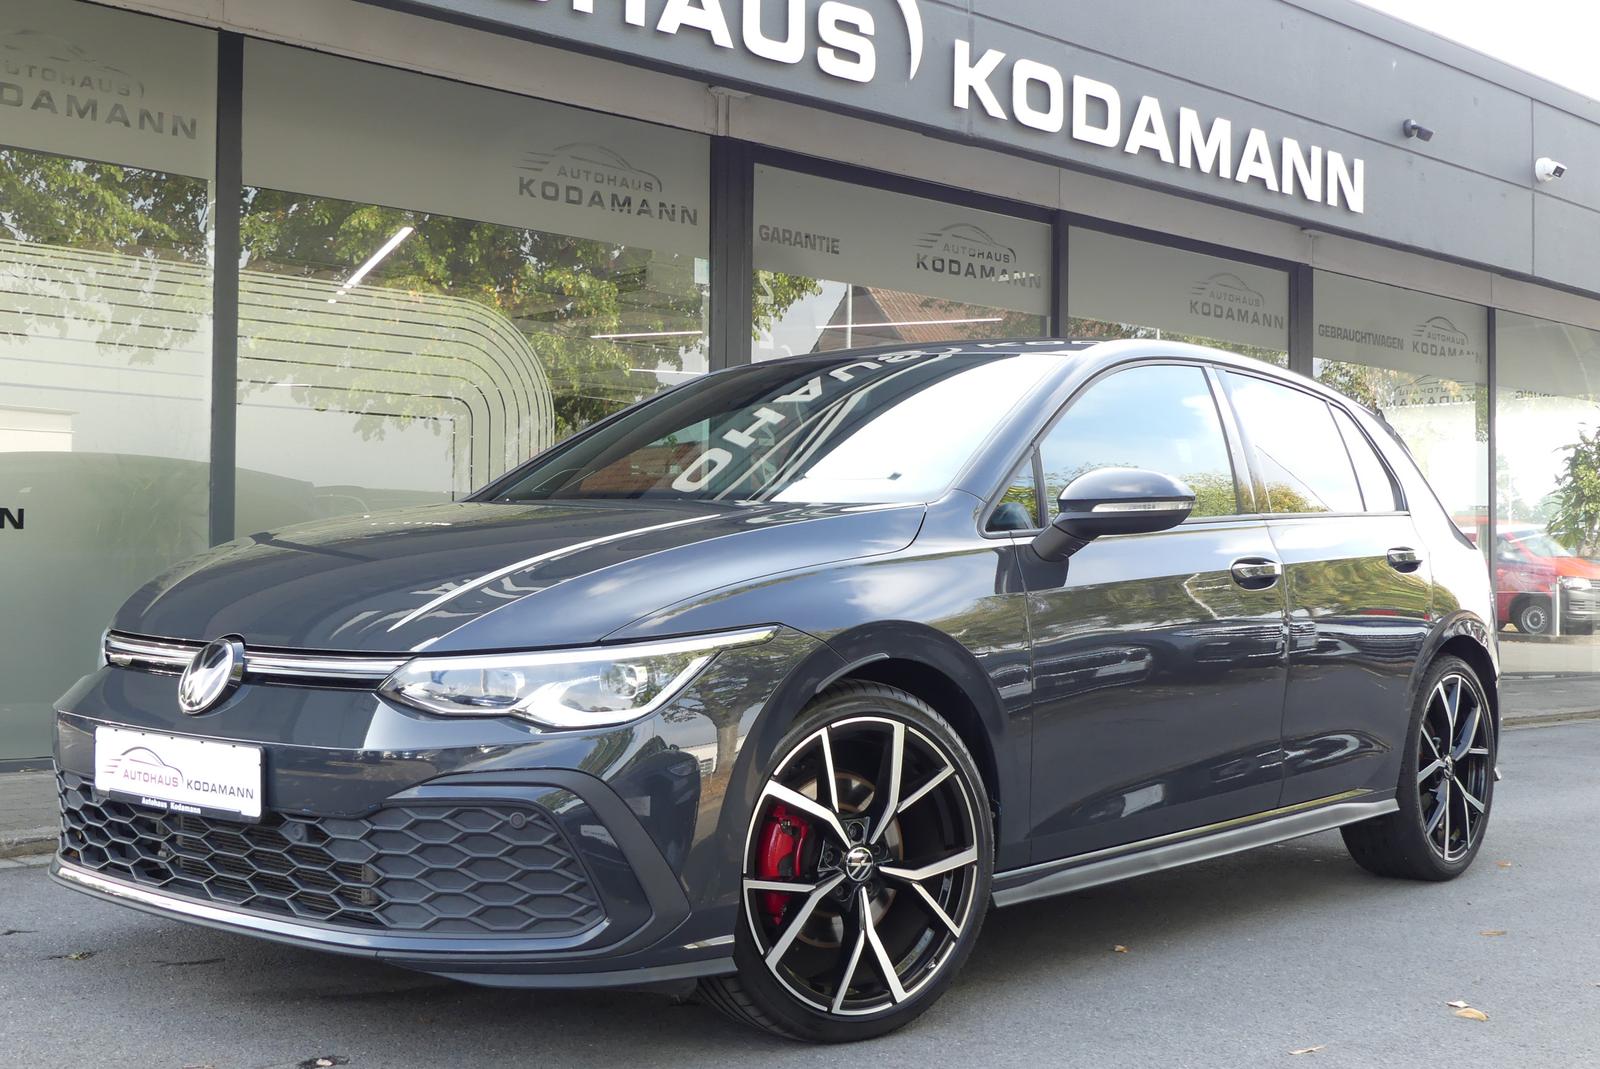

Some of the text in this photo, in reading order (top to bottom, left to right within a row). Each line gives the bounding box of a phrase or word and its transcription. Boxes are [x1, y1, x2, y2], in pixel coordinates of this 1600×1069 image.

[522, 0, 877, 83] AUS
[953, 39, 1364, 214] KODAMANN
[557, 165, 653, 192] AUTOHAUS
[518, 176, 698, 226] KODAMANN
[758, 224, 840, 255] GARANTIE
[943, 242, 1010, 264] AUTOHAUS
[916, 253, 1041, 289] KODAMANN
[1189, 299, 1285, 329] KODAMANN
[1318, 324, 1404, 350] GEBRAUCHTWAGEN
[123, 769, 254, 800] AUTOHAUS KODAMANN
